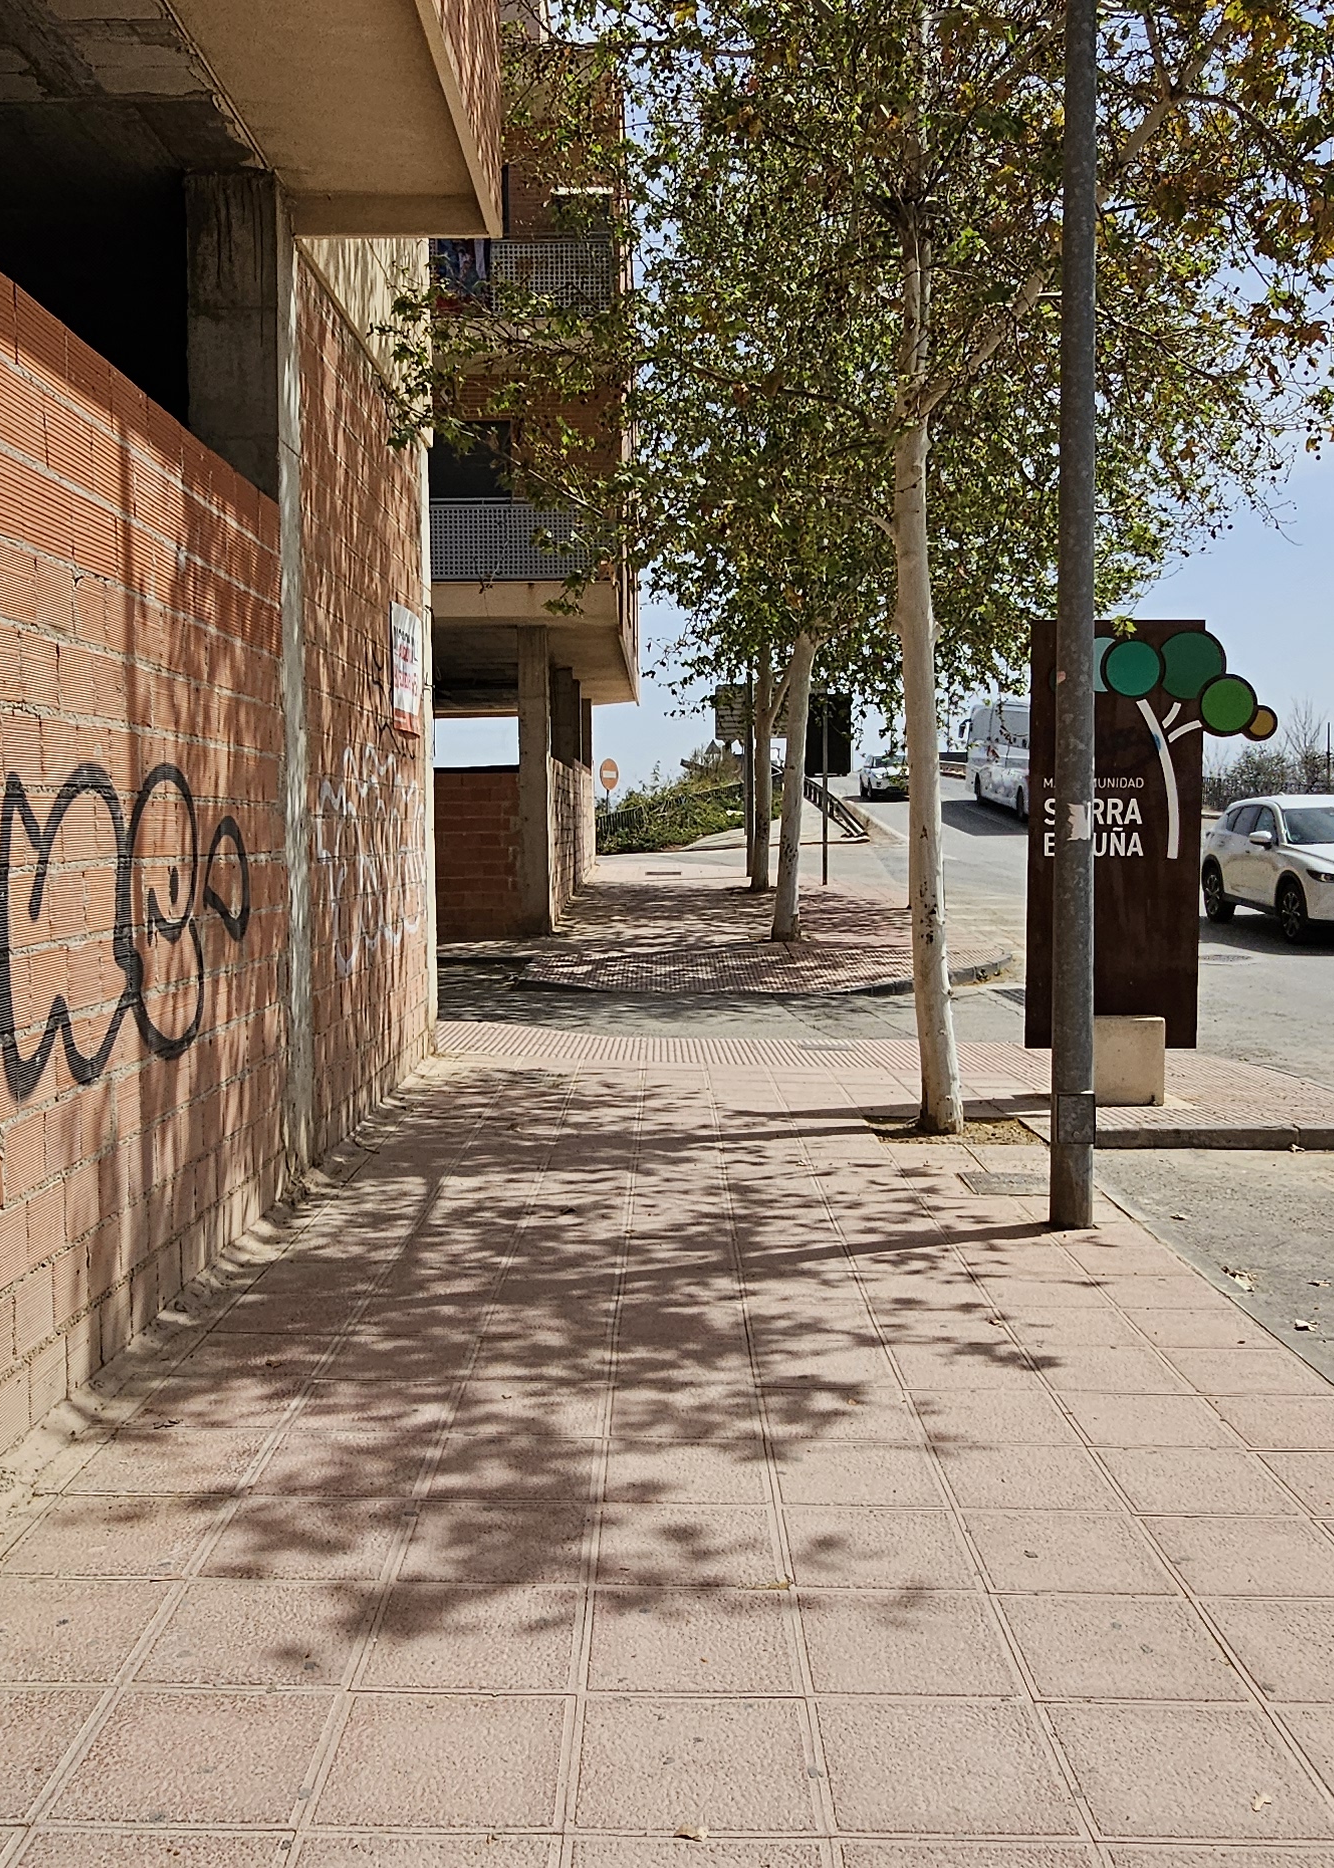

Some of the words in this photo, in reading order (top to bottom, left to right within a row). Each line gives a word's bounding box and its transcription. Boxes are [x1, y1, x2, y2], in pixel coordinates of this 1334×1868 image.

[1043, 777, 1145, 789] MUNIDAD
[1043, 797, 1143, 826] SRRA
[1043, 826, 1145, 857] EUÑA
